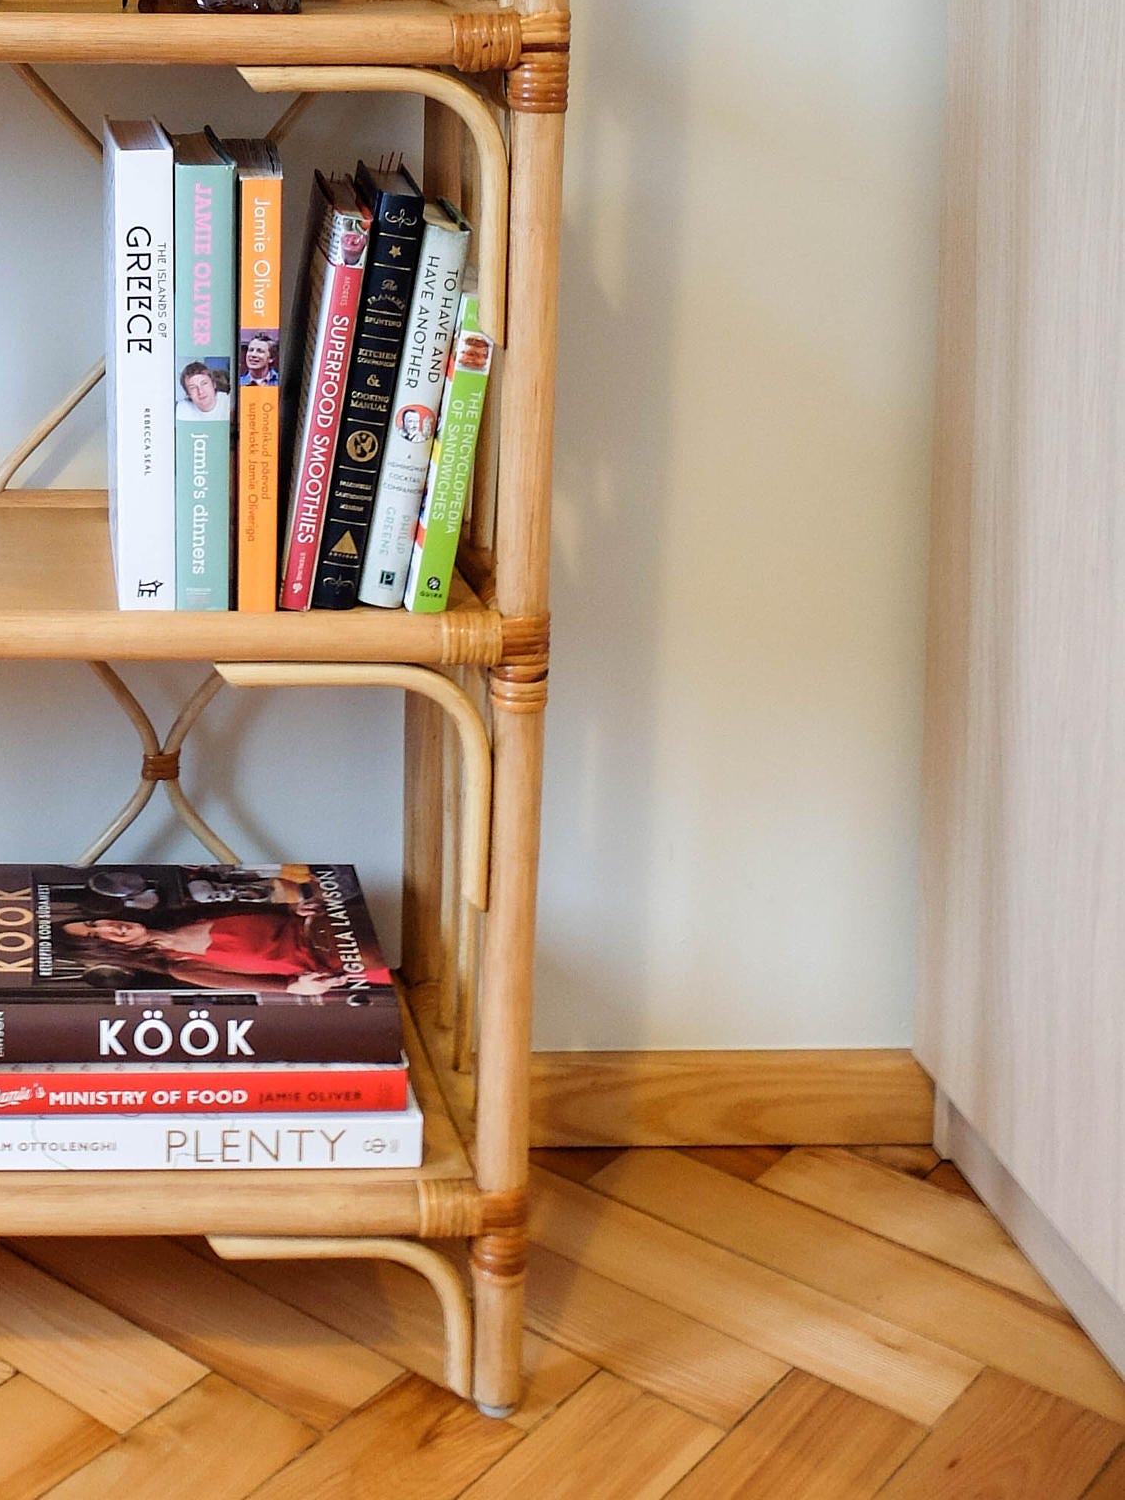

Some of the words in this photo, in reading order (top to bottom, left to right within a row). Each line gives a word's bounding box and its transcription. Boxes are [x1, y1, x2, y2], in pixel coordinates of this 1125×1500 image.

[195, 182, 213, 255] JAMIE
[253, 198, 271, 252] Jamie
[157, 242, 167, 264] THE
[126, 226, 152, 354] GREECE
[157, 269, 167, 318] ISLANDS
[253, 260, 271, 316] Oliver
[421, 255, 441, 300] HAVE
[444, 270, 459, 292] TO
[193, 262, 212, 346] OLIVER
[435, 296, 453, 341] HAVE
[158, 322, 167, 338] OF
[405, 304, 429, 388] ANOTHER
[316, 314, 349, 429] SUPERFOOD
[358, 348, 397, 360] KITCHEN
[427, 346, 443, 384] AND
[351, 390, 389, 403] COOKING
[367, 374, 381, 388] &
[350, 399, 387, 412] MANUAL
[451, 400, 464, 420] OF
[466, 391, 481, 419] THE
[143, 408, 151, 450] REBECCA
[247, 402, 259, 454] superkokk
[247, 460, 258, 490] Jamie
[297, 434, 330, 544] SMOOTHIES
[432, 424, 460, 520] SANDWICHES
[445, 424, 475, 534] ENCYCLOPEDIA
[193, 504, 209, 575] dinners
[245, 494, 259, 542] Oliveriga
[397, 514, 411, 554] PHILIP
[315, 870, 351, 926] LAWSON
[38, 920, 52, 940] KODU
[39, 941, 53, 976] RETSEPTID
[334, 930, 371, 990] NIGELLA
[99, 1010, 255, 1056] KÖÖK
[49, 1090, 147, 1106] MINISTRY
[151, 1090, 182, 1105] OF
[187, 1090, 249, 1104] FOOD
[259, 1091, 302, 1104] JAMIE
[307, 1091, 363, 1102] OLIVER
[17, 1142, 118, 1152] OTTOLENGHI
[166, 1129, 346, 1163] PLENTY
